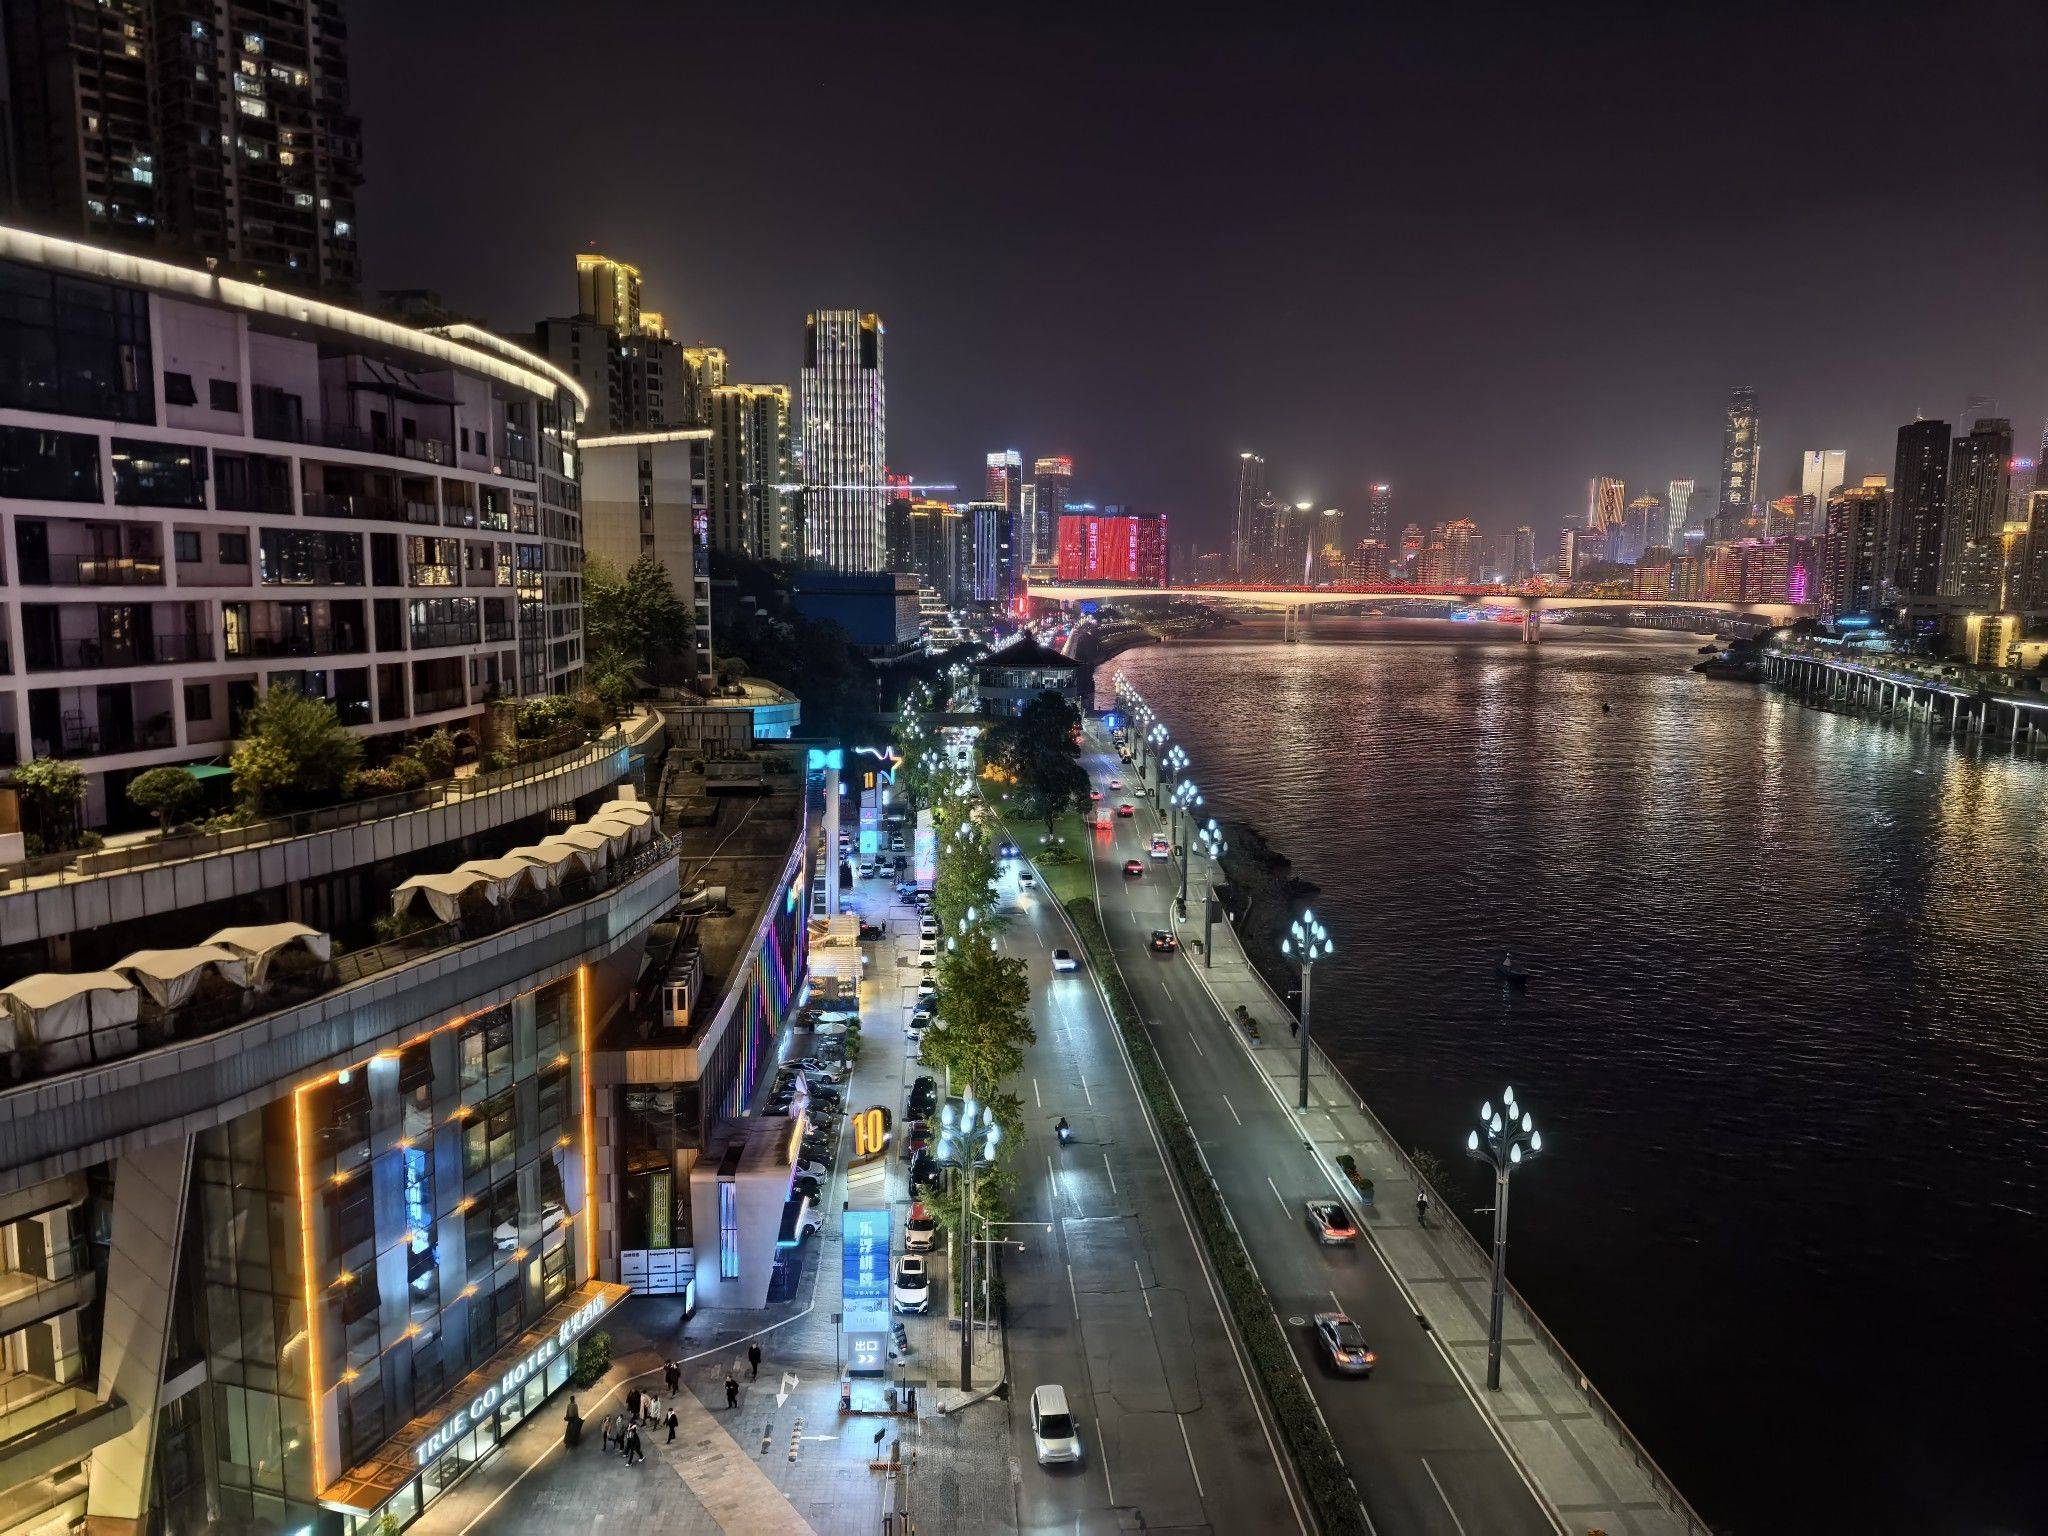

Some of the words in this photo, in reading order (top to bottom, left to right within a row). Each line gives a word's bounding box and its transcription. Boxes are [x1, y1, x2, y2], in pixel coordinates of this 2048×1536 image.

[852, 1109, 883, 1157] 10
[855, 1340, 878, 1351] 出口
[415, 1411, 470, 1466] TRUE
[502, 1340, 555, 1395] HOTEL
